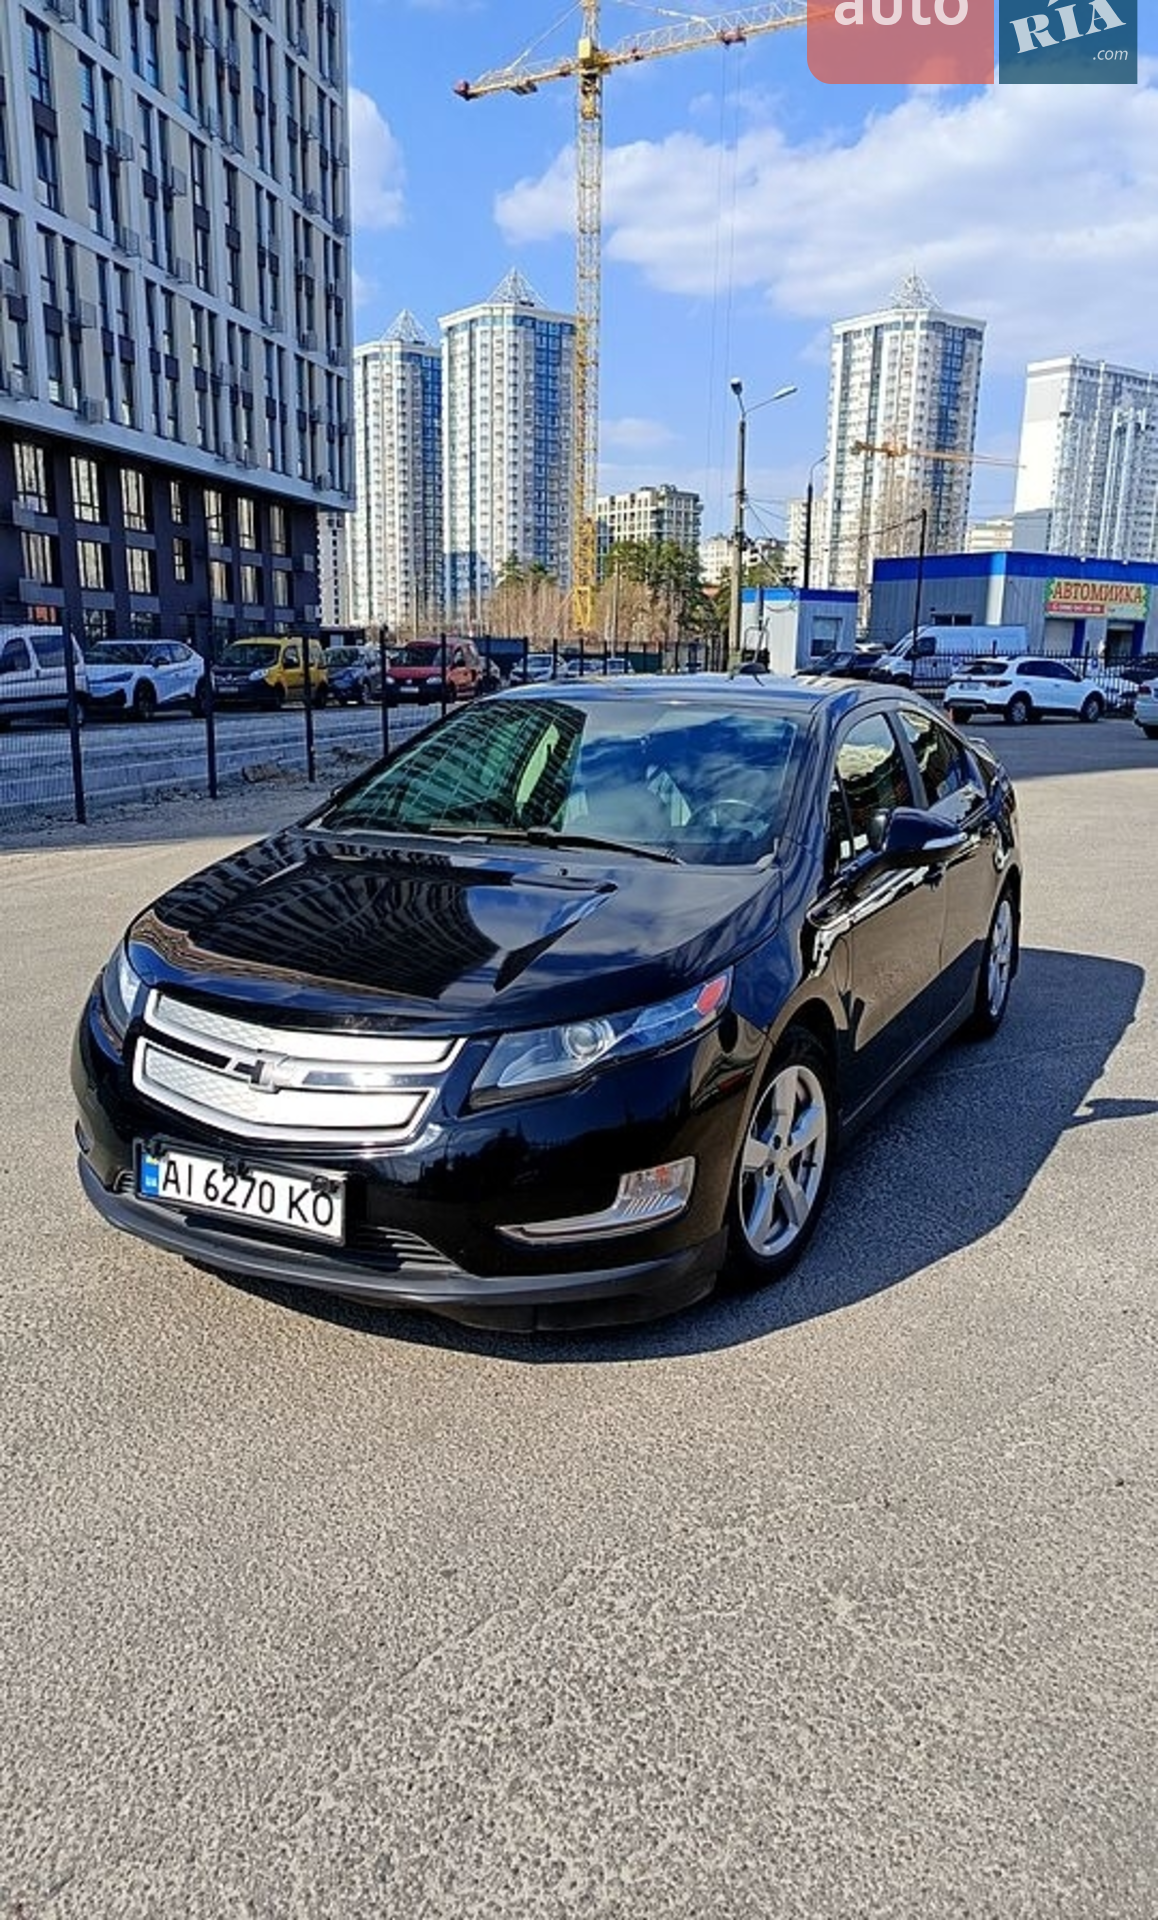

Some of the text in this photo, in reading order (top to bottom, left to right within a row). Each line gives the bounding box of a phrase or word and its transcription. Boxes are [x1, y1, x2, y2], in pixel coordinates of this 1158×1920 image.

[162, 1160, 334, 1226] AI 6270 KO
